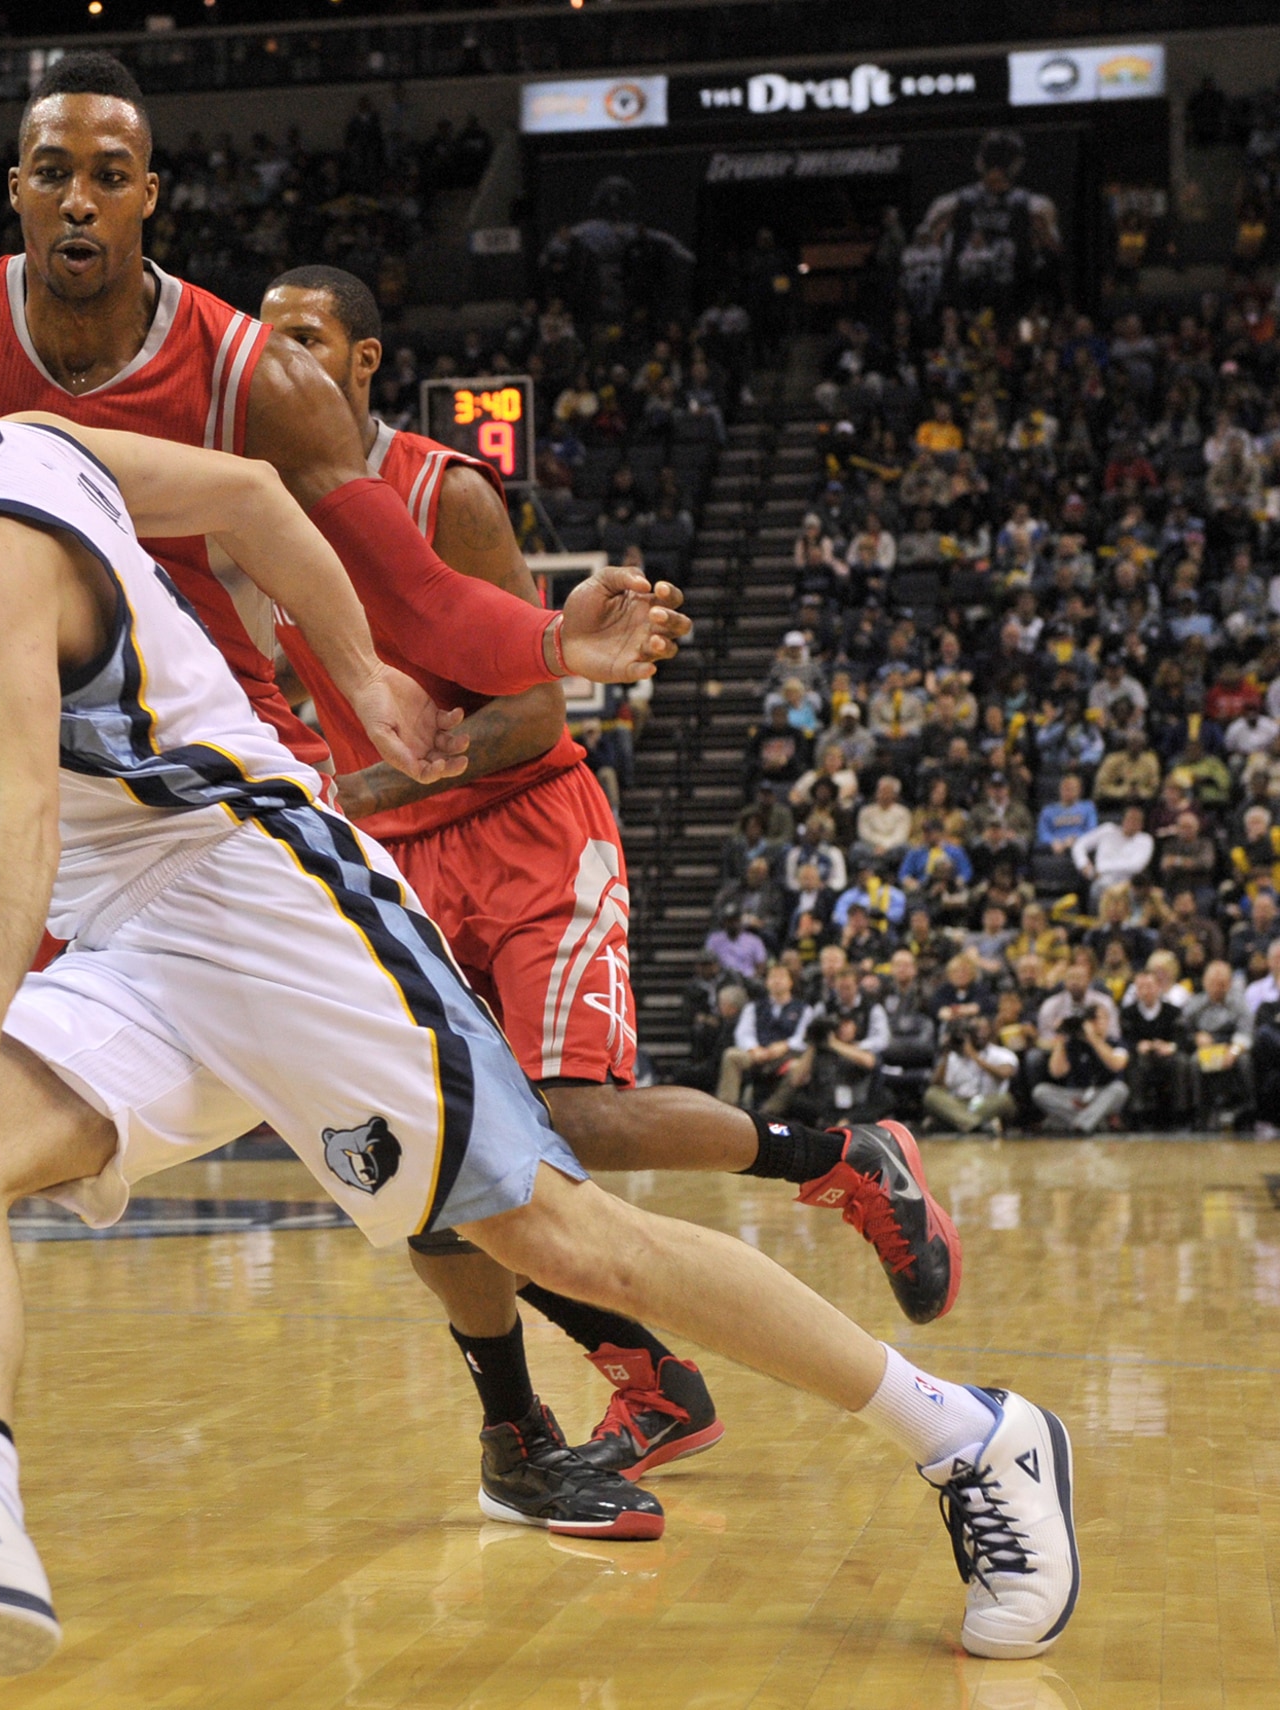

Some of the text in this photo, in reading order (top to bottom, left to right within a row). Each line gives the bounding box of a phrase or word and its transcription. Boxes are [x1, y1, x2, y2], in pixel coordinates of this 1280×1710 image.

[747, 63, 895, 114] Draft
[454, 387, 521, 424] 3:40
[478, 421, 515, 475] 9
